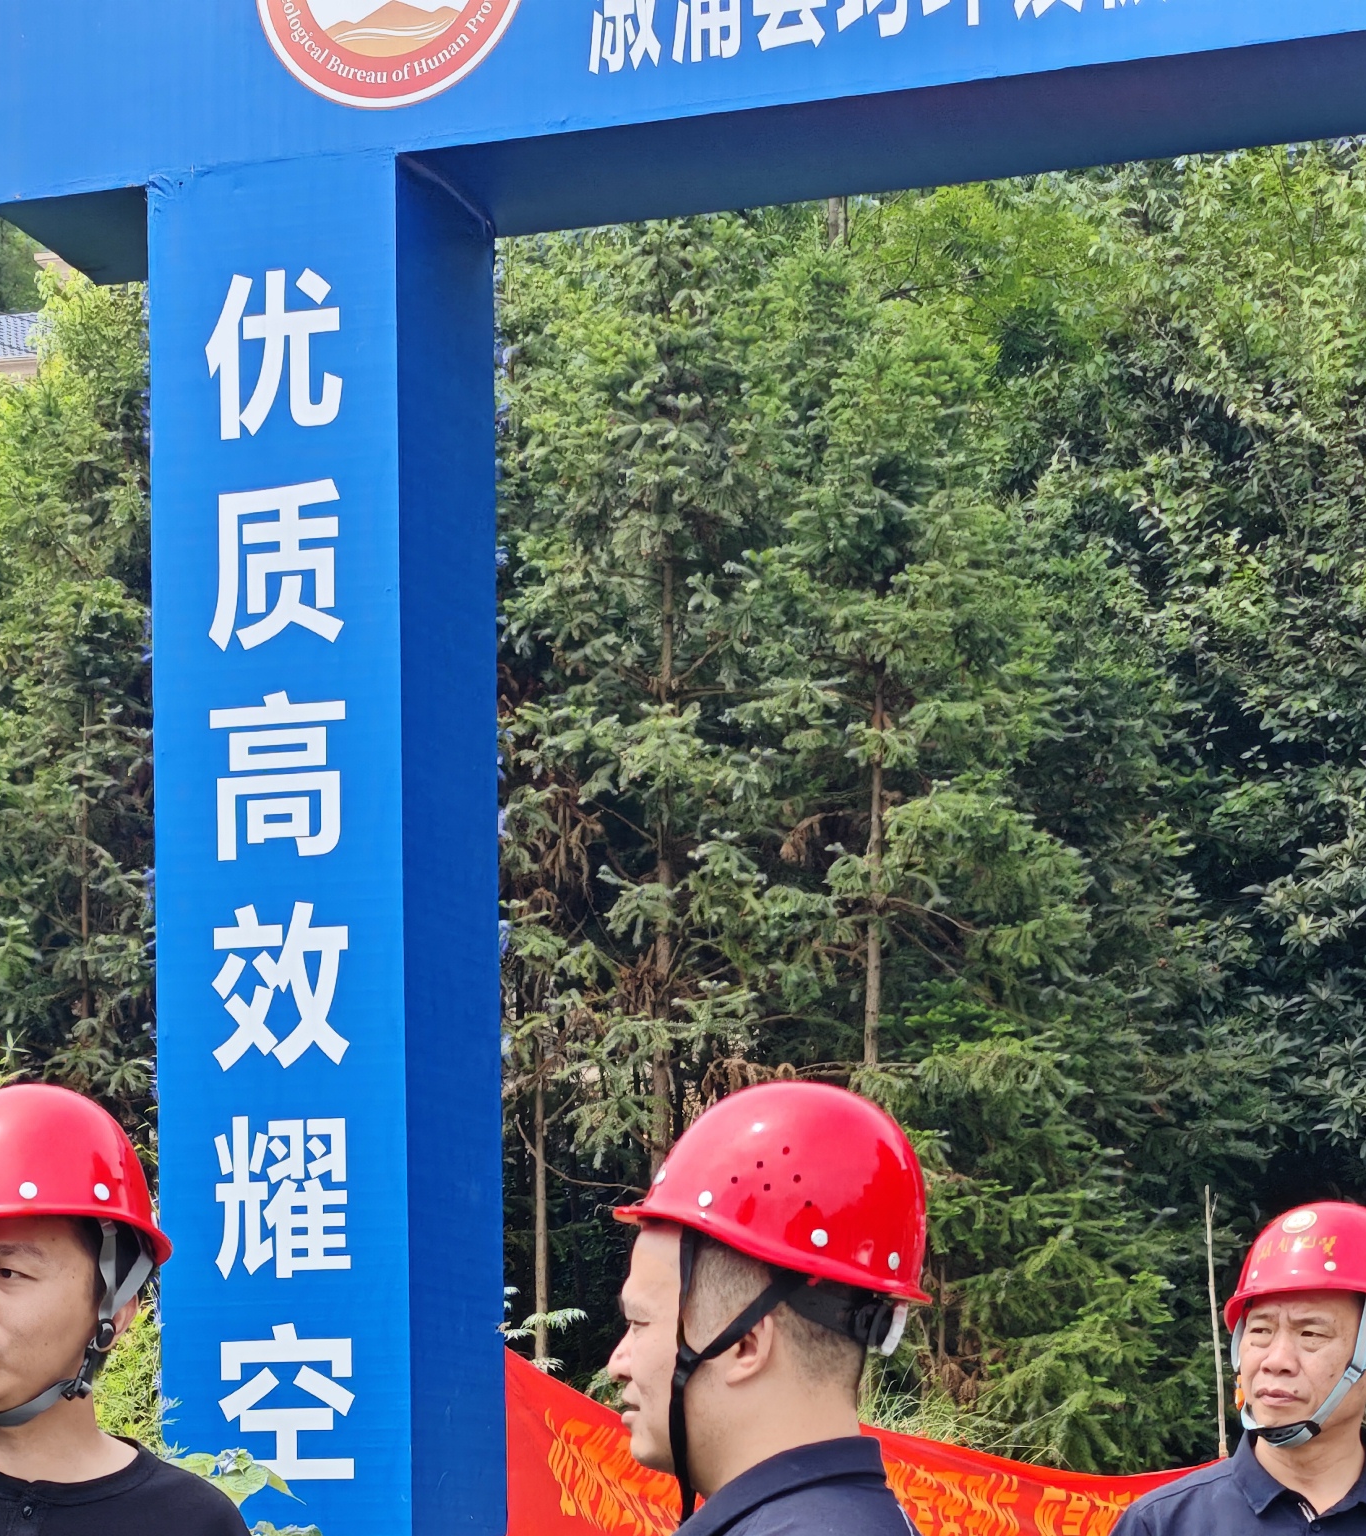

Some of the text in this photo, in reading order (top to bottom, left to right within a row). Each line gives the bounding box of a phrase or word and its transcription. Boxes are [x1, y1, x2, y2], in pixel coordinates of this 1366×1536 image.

[282, 0, 493, 84] ological Bureau of Hunan Pro
